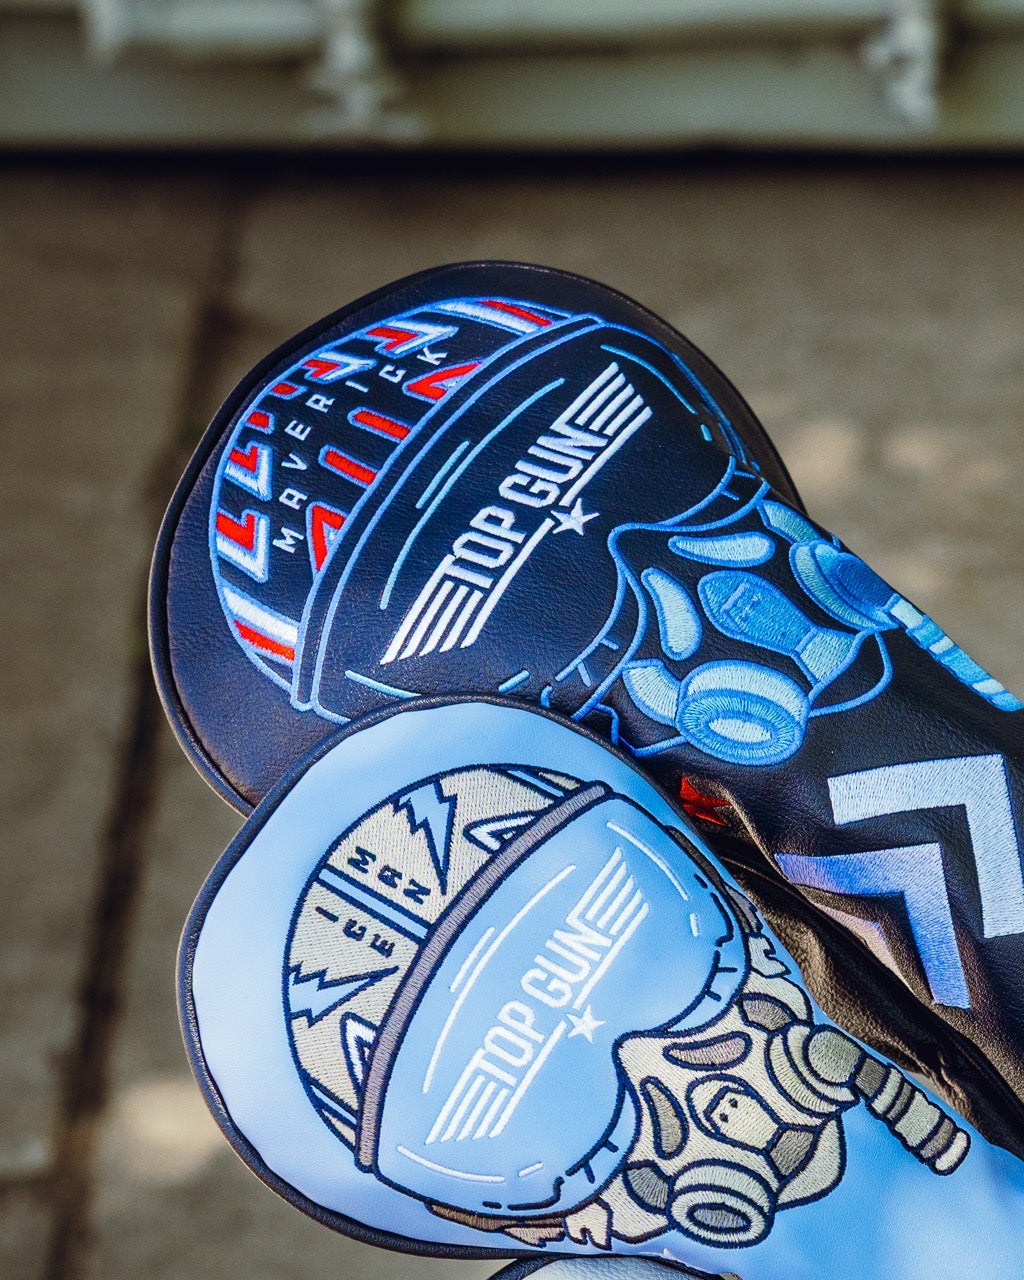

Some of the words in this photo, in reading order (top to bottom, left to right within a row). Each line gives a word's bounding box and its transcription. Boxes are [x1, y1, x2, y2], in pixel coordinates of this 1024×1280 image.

[273, 346, 448, 554] MAVERICK
[444, 505, 527, 589] TOP
[498, 421, 609, 508] GUN
[476, 1000, 545, 1086] TOP
[520, 917, 613, 1008] GUN
